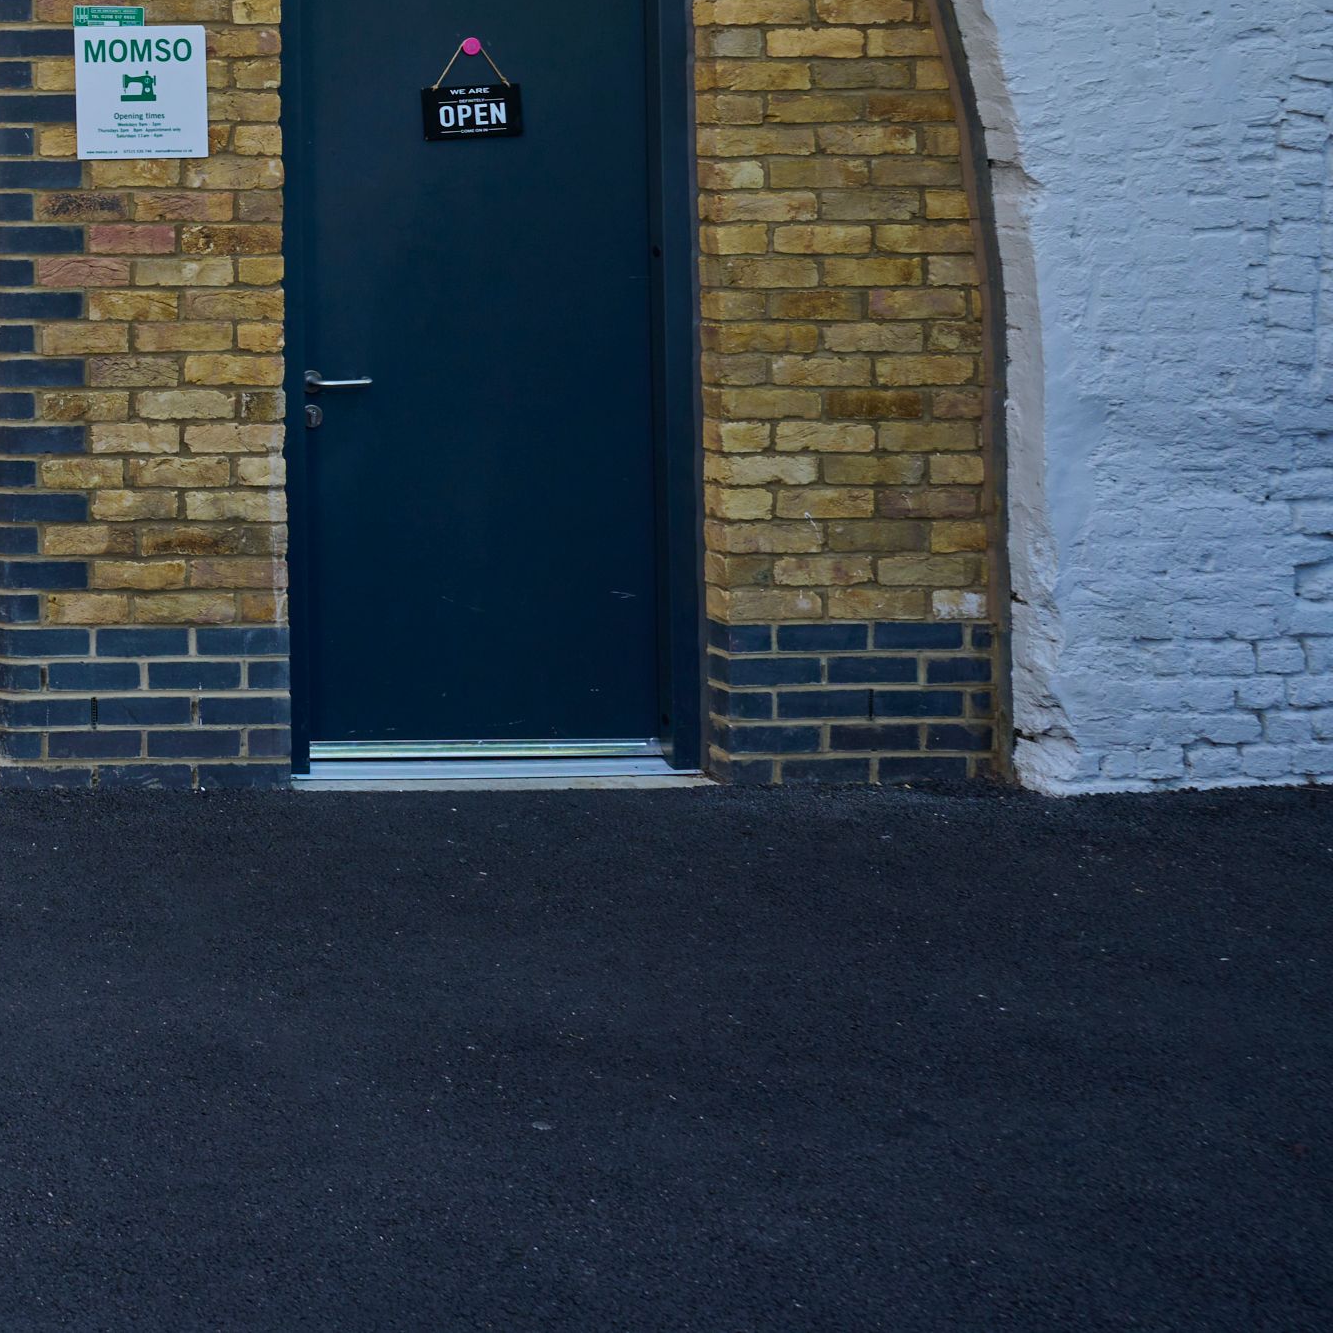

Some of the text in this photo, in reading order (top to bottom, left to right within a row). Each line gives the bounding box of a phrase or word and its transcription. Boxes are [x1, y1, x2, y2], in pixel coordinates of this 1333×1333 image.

[84, 38, 192, 63] MOMSO
[468, 87, 490, 95] ARE
[113, 112, 165, 121] Opening times
[439, 102, 507, 128] OPEN
